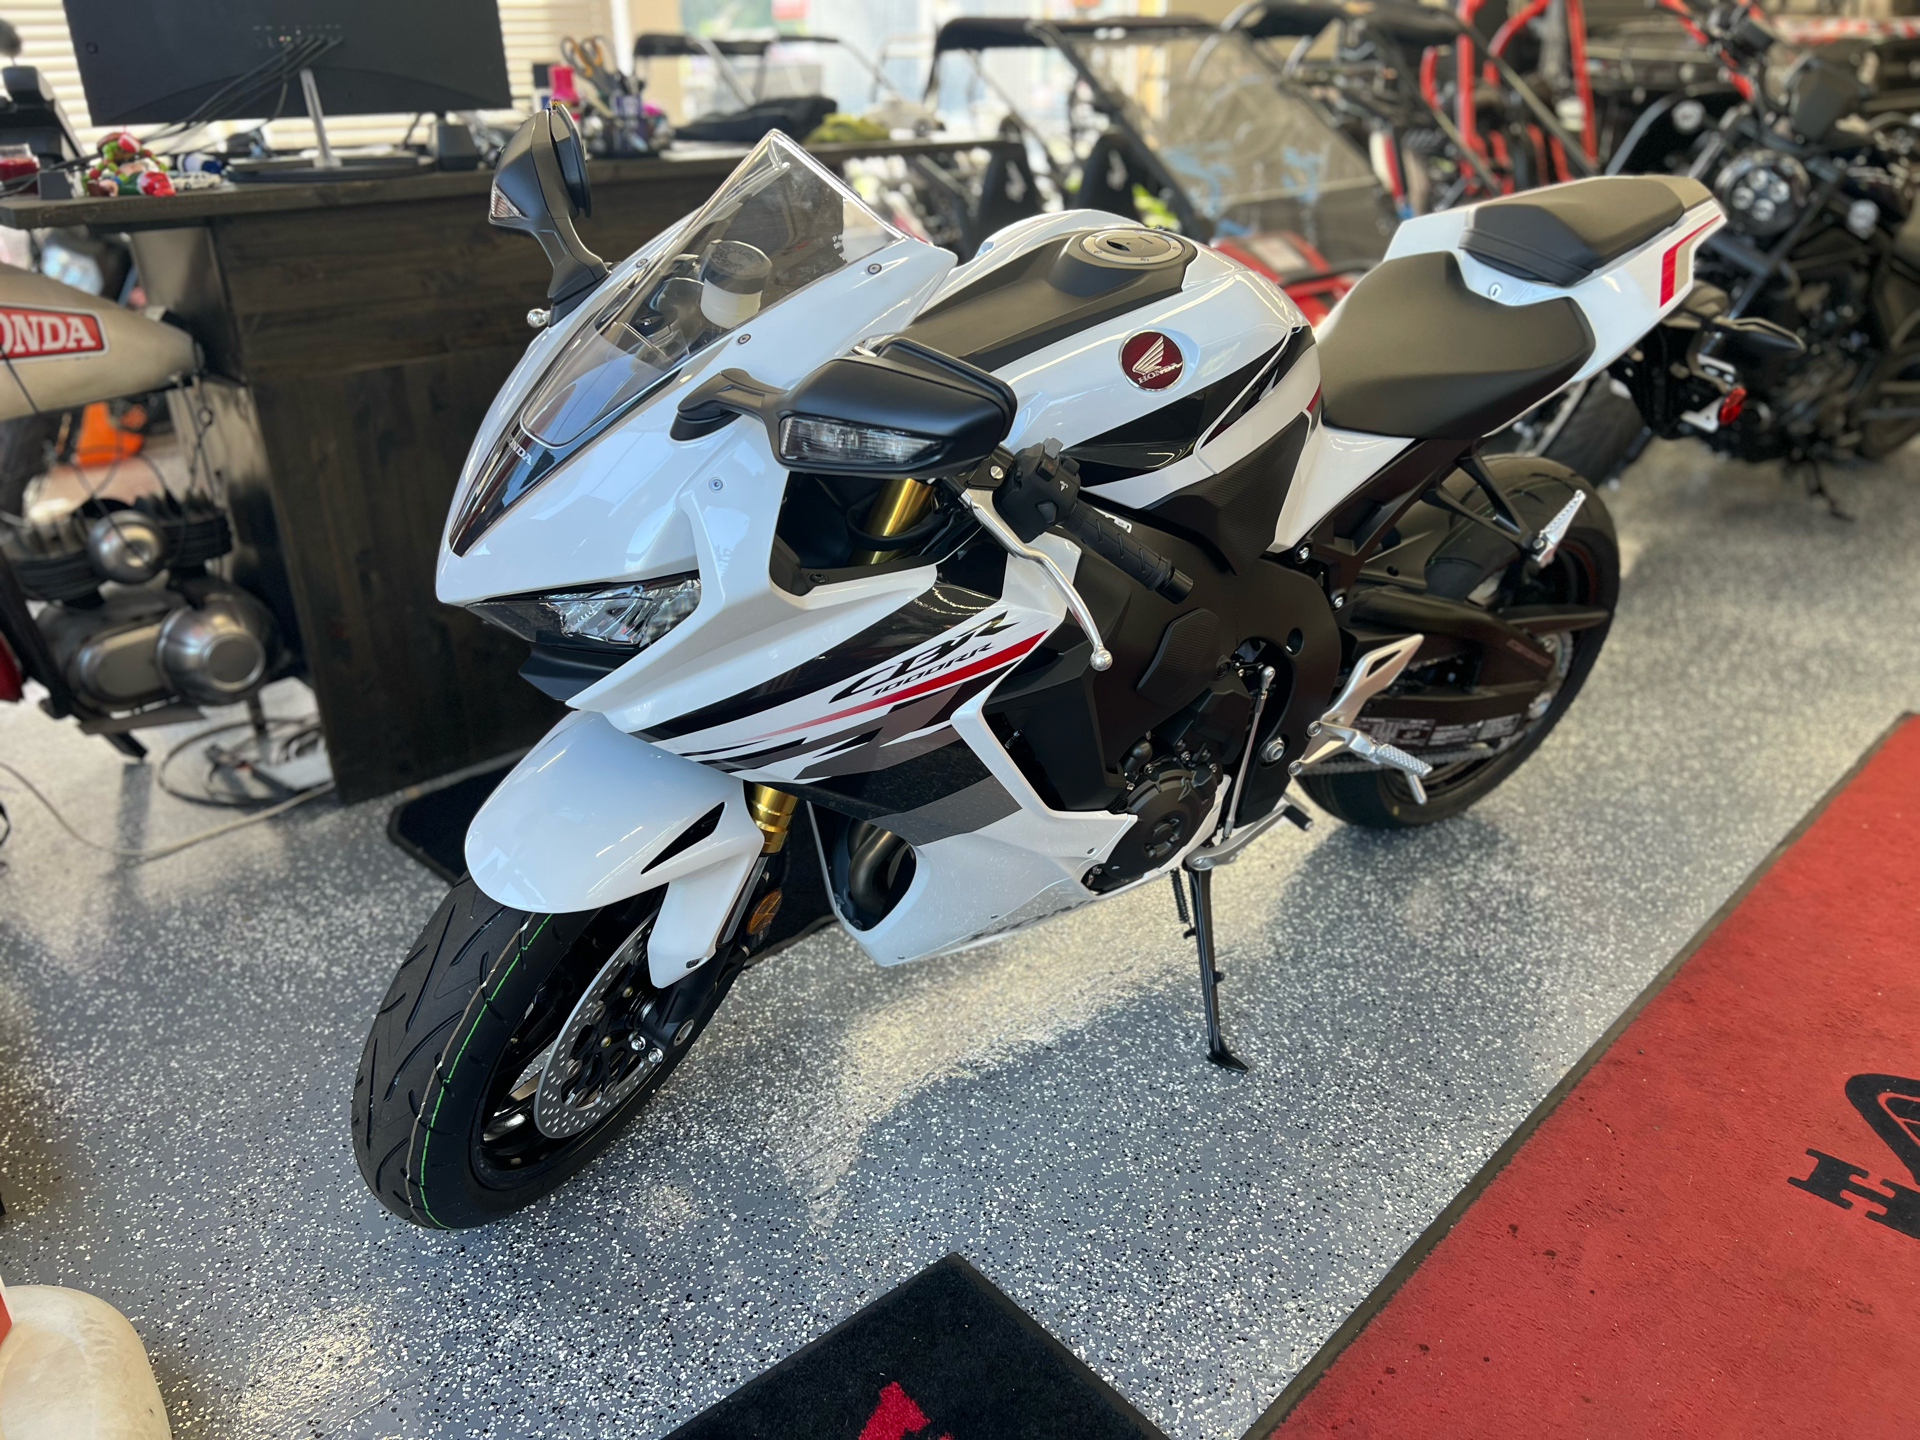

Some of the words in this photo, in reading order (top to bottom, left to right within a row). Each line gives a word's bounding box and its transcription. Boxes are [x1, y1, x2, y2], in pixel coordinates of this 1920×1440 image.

[1137, 362, 1183, 384] HONDA
[828, 610, 1021, 704] CBR
[872, 642, 995, 697] 1000RR
